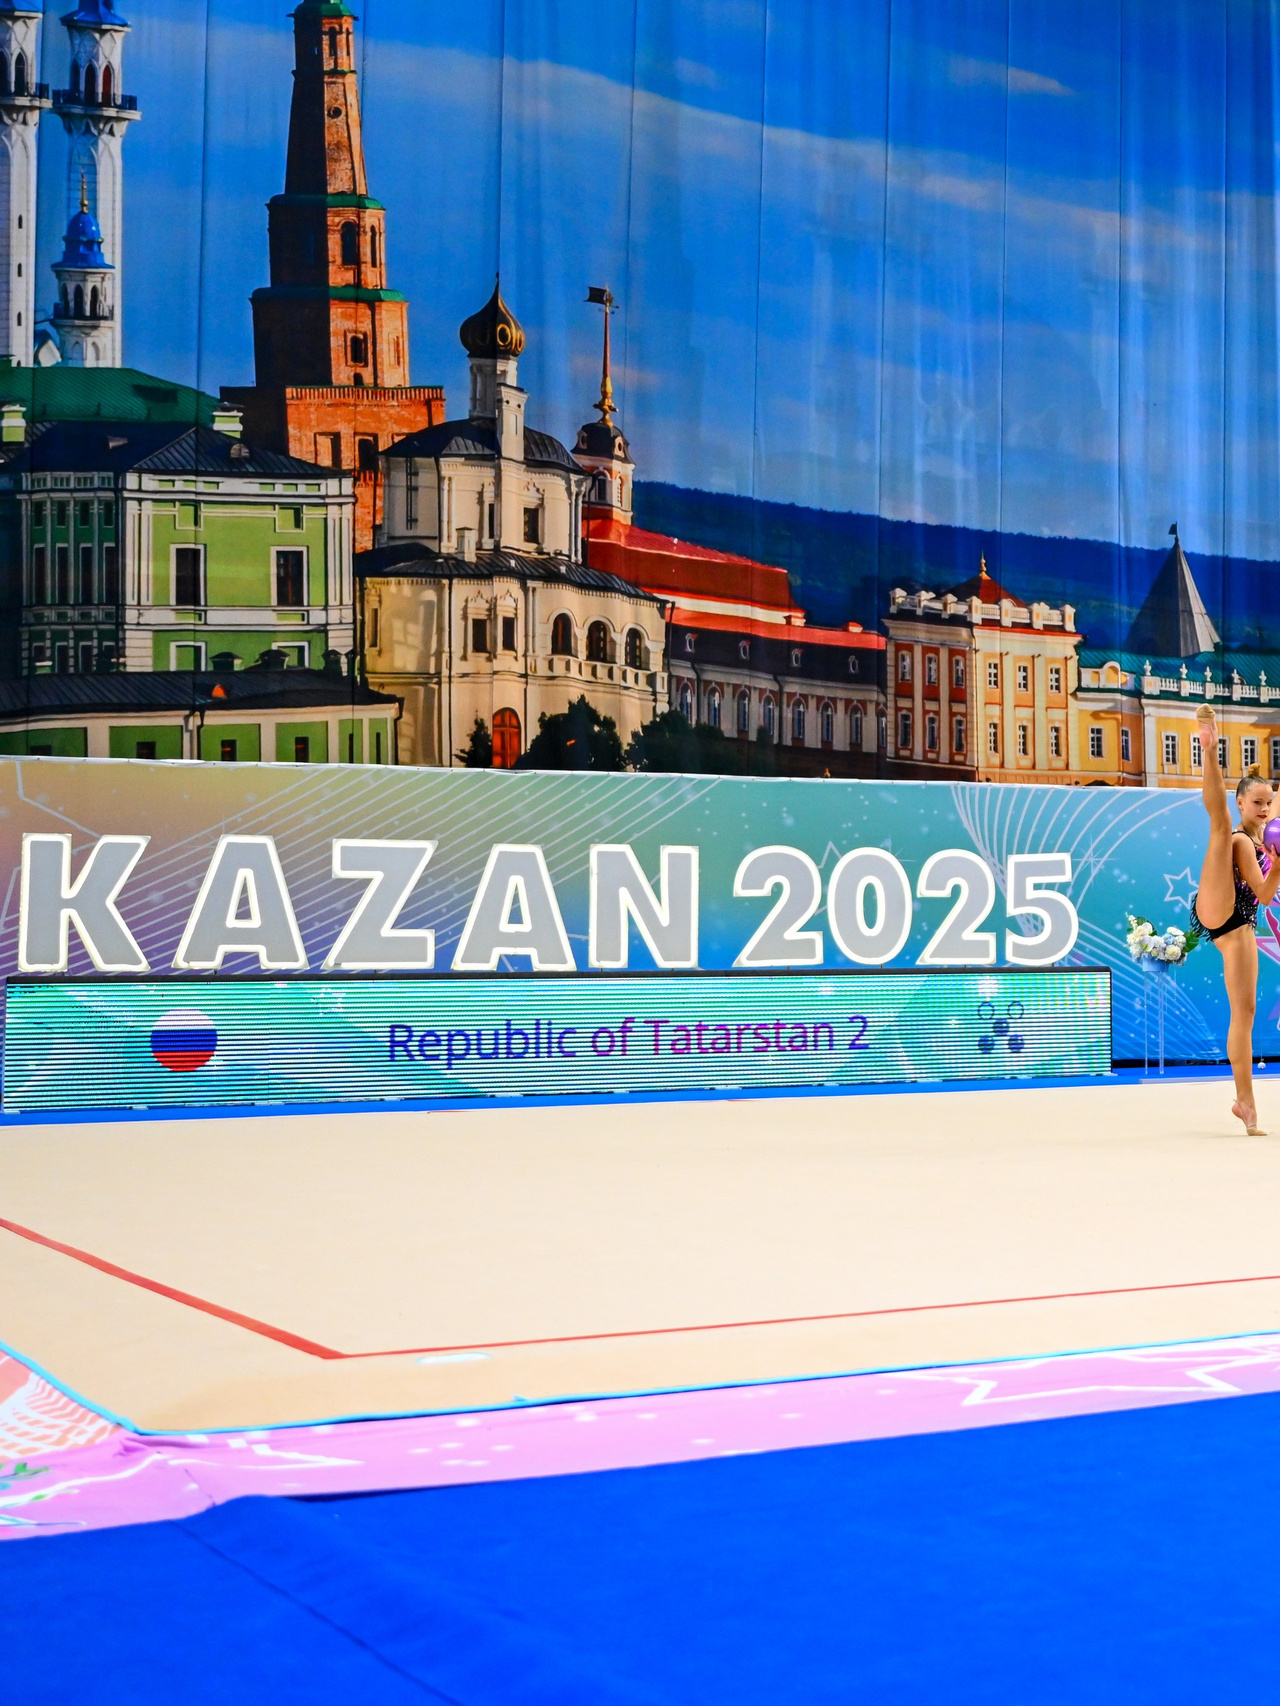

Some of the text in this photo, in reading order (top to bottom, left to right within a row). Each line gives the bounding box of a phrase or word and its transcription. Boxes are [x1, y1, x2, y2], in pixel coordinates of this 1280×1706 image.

[18, 833, 1079, 972] KAZAN 2025
[388, 1014, 870, 1070] Republic of Tatarstan 2
